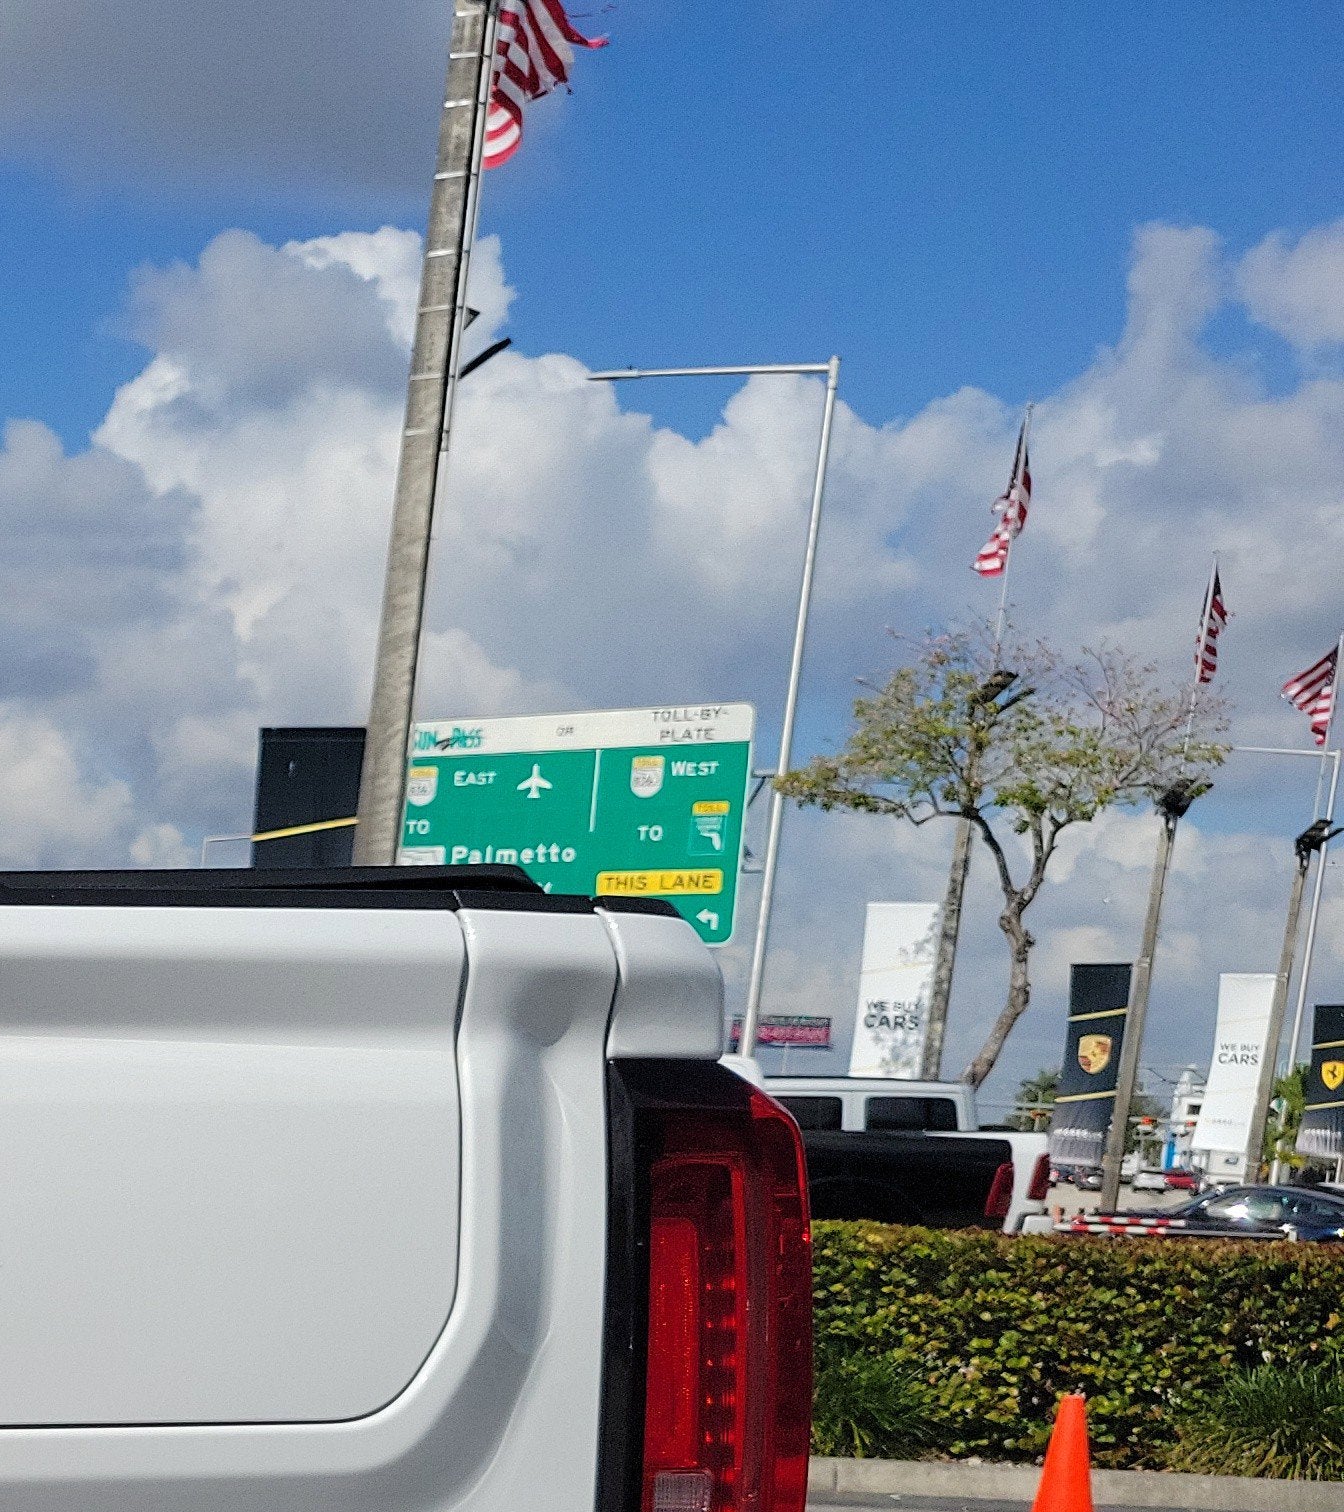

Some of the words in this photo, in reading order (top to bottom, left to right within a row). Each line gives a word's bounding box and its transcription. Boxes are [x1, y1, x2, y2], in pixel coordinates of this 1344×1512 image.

[660, 727, 716, 742] PLATE
[671, 760, 720, 777] WEST
[453, 769, 497, 787] EAST
[406, 818, 431, 835] TO
[637, 824, 664, 842] TO
[450, 842, 578, 866] Palmetto
[604, 875, 648, 891] THIS
[659, 872, 715, 891] LANE
[867, 999, 889, 1011] WE
[864, 1014, 920, 1031] CARS
[1217, 1052, 1259, 1066] CARS
